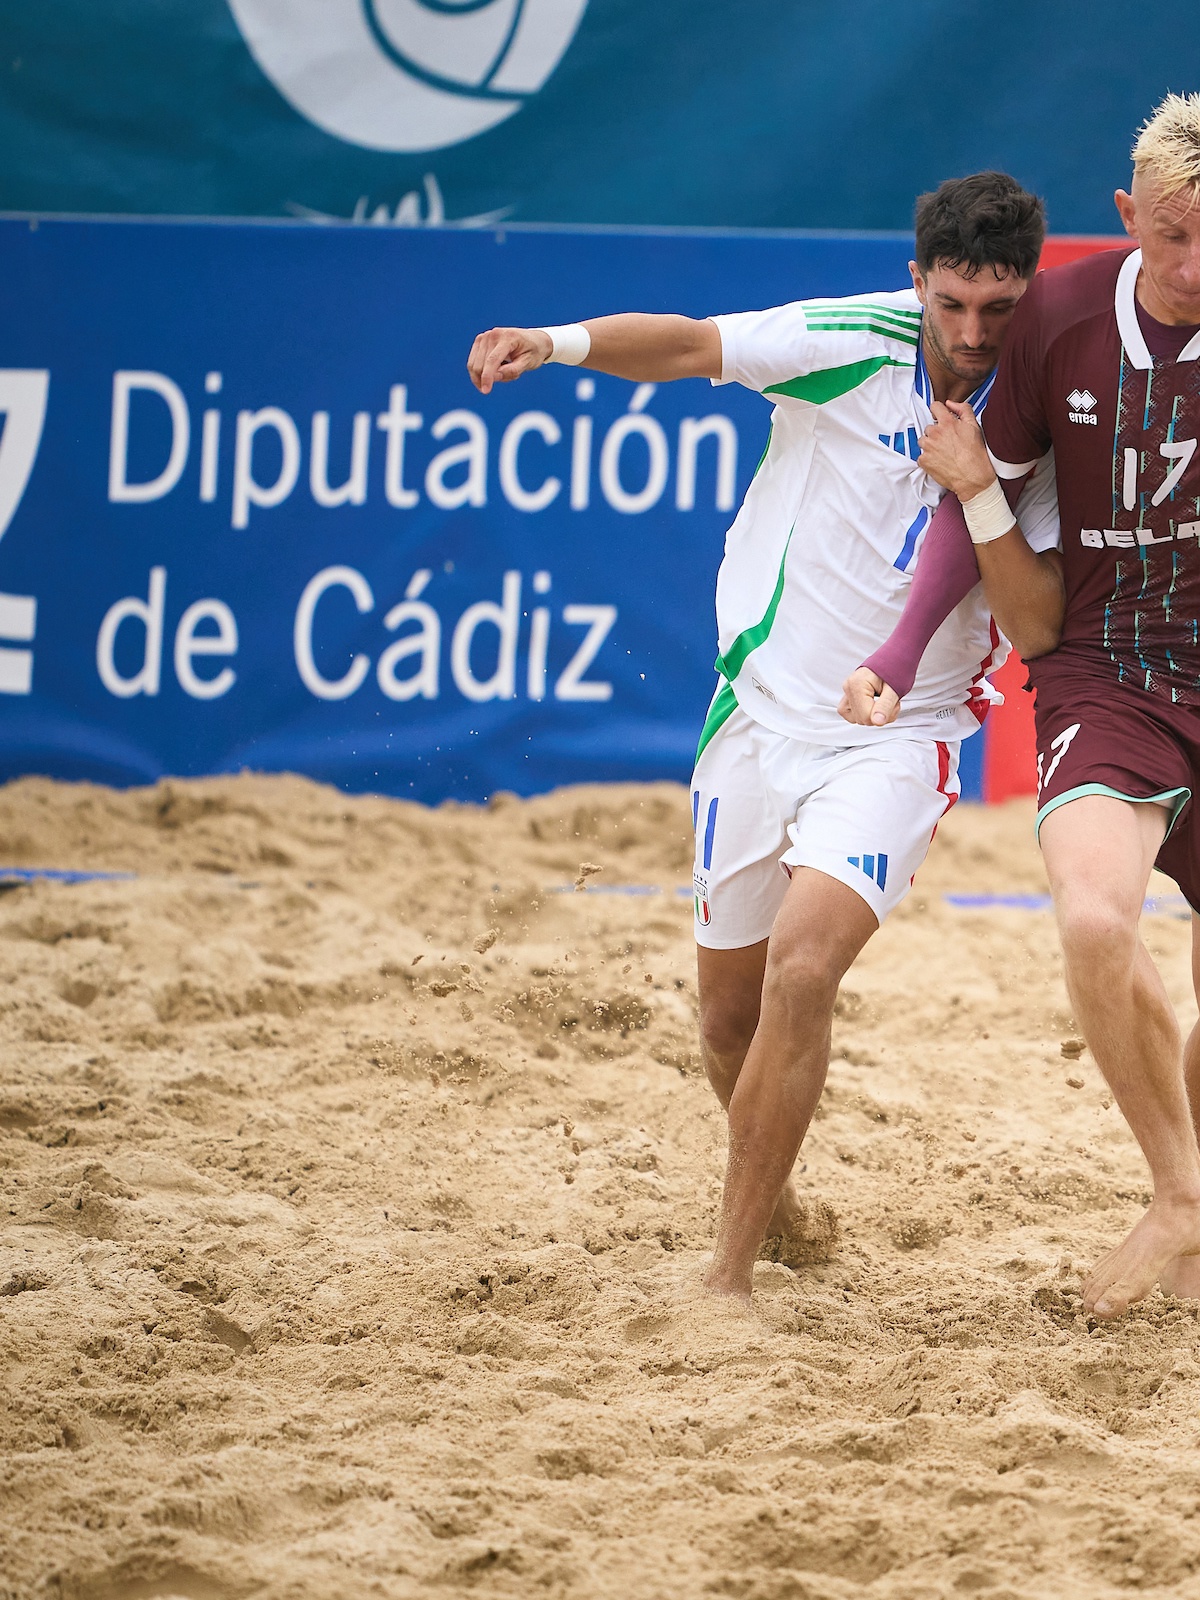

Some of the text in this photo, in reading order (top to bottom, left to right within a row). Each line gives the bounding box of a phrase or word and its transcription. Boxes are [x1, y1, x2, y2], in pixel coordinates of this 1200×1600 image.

[107, 369, 739, 530] Diputación
[1068, 412, 1098, 425] errea
[1122, 438, 1198, 511] 17
[95, 566, 239, 699] de
[292, 566, 618, 703] Cádiz
[1037, 723, 1081, 800] 17
